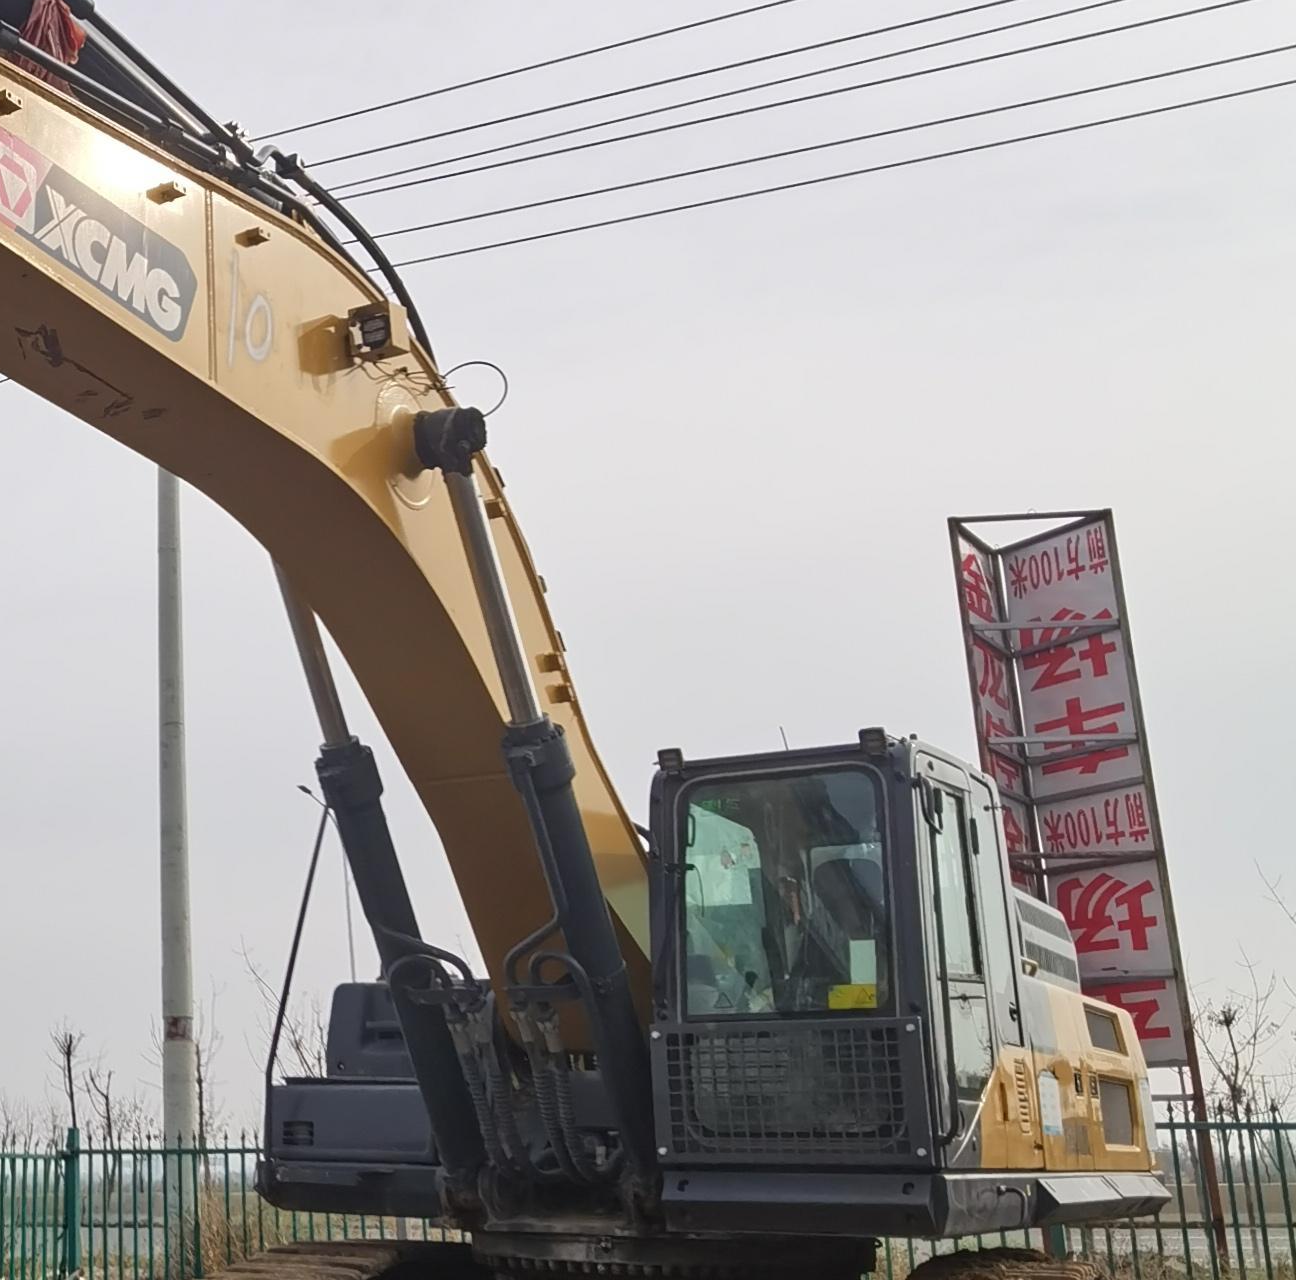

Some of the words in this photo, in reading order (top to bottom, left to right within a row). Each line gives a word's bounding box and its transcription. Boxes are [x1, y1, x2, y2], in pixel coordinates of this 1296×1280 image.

[33, 183, 183, 333] XCMG
[1008, 525, 1109, 600] 前方100米
[1043, 791, 1150, 853] 前方100米
